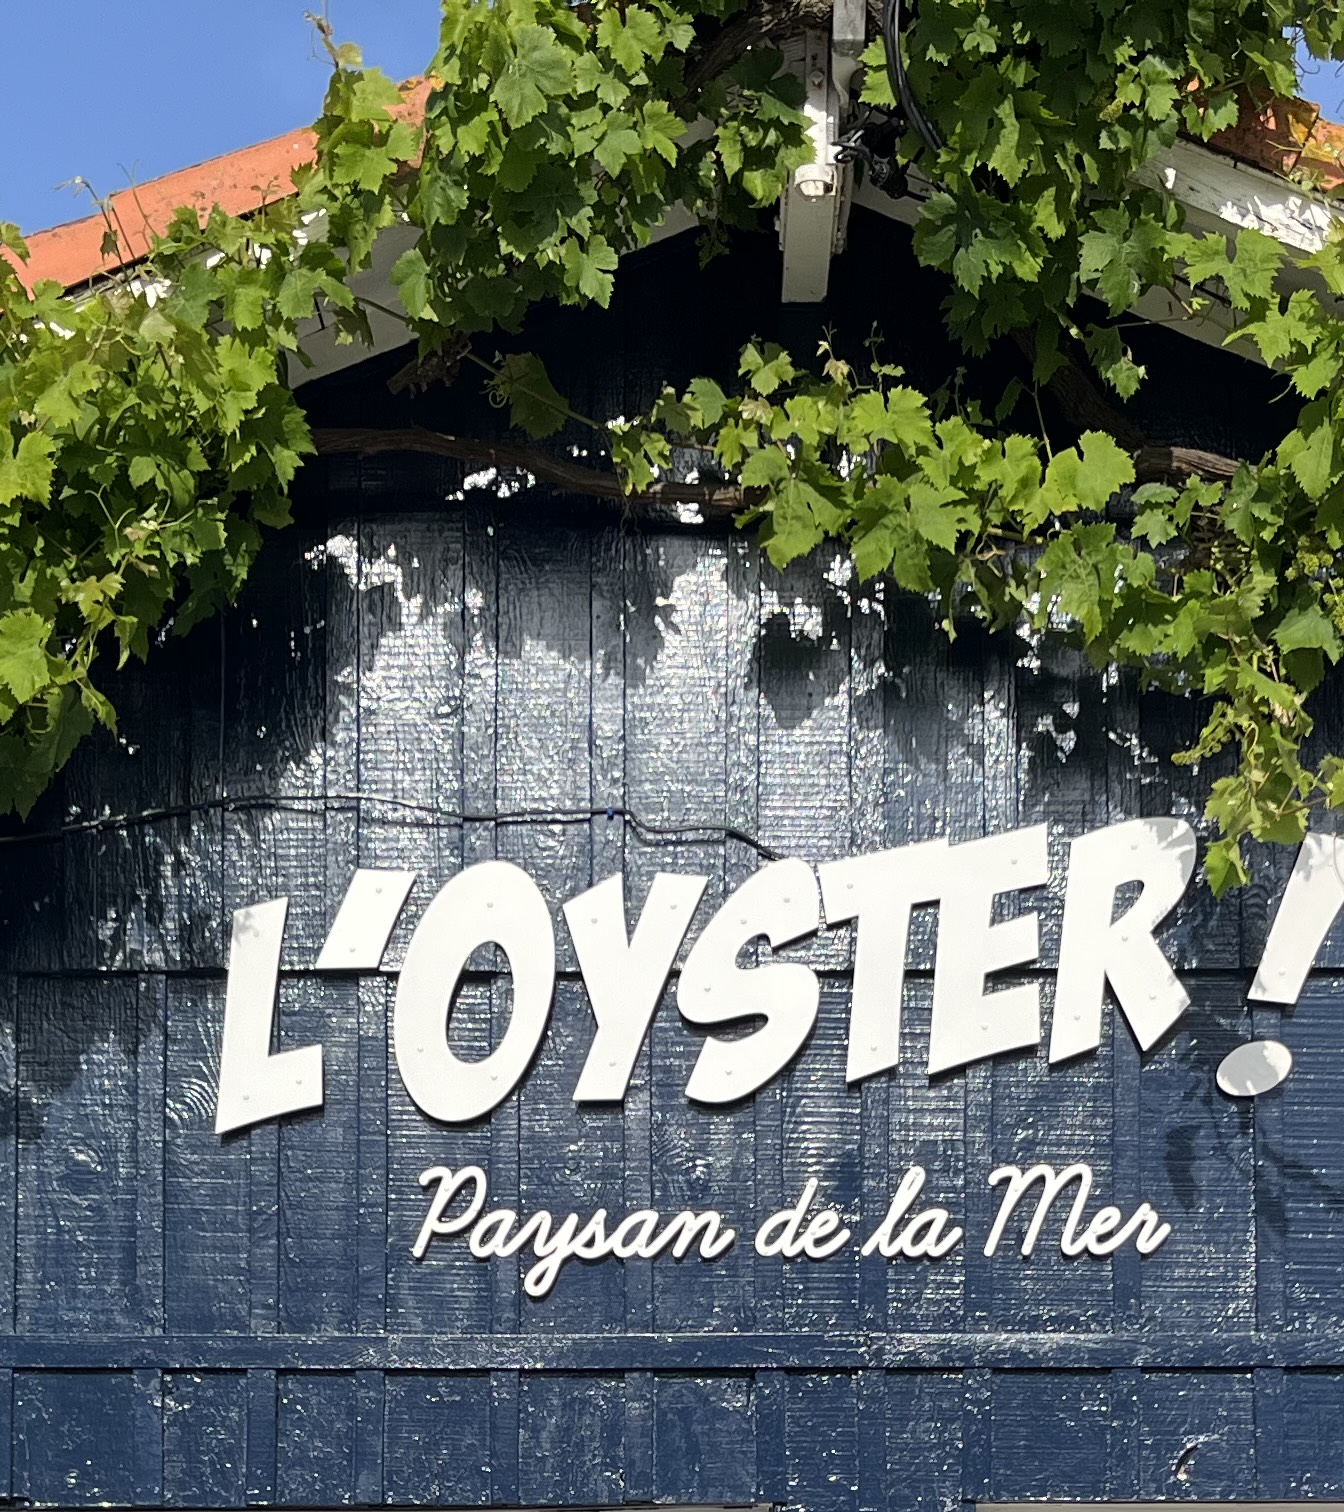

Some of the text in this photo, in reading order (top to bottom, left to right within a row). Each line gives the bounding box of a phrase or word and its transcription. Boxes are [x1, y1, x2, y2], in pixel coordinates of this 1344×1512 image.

[215, 817, 1198, 1135] L'OYSTER
[410, 1161, 1172, 1300] Paysan de la Mer
